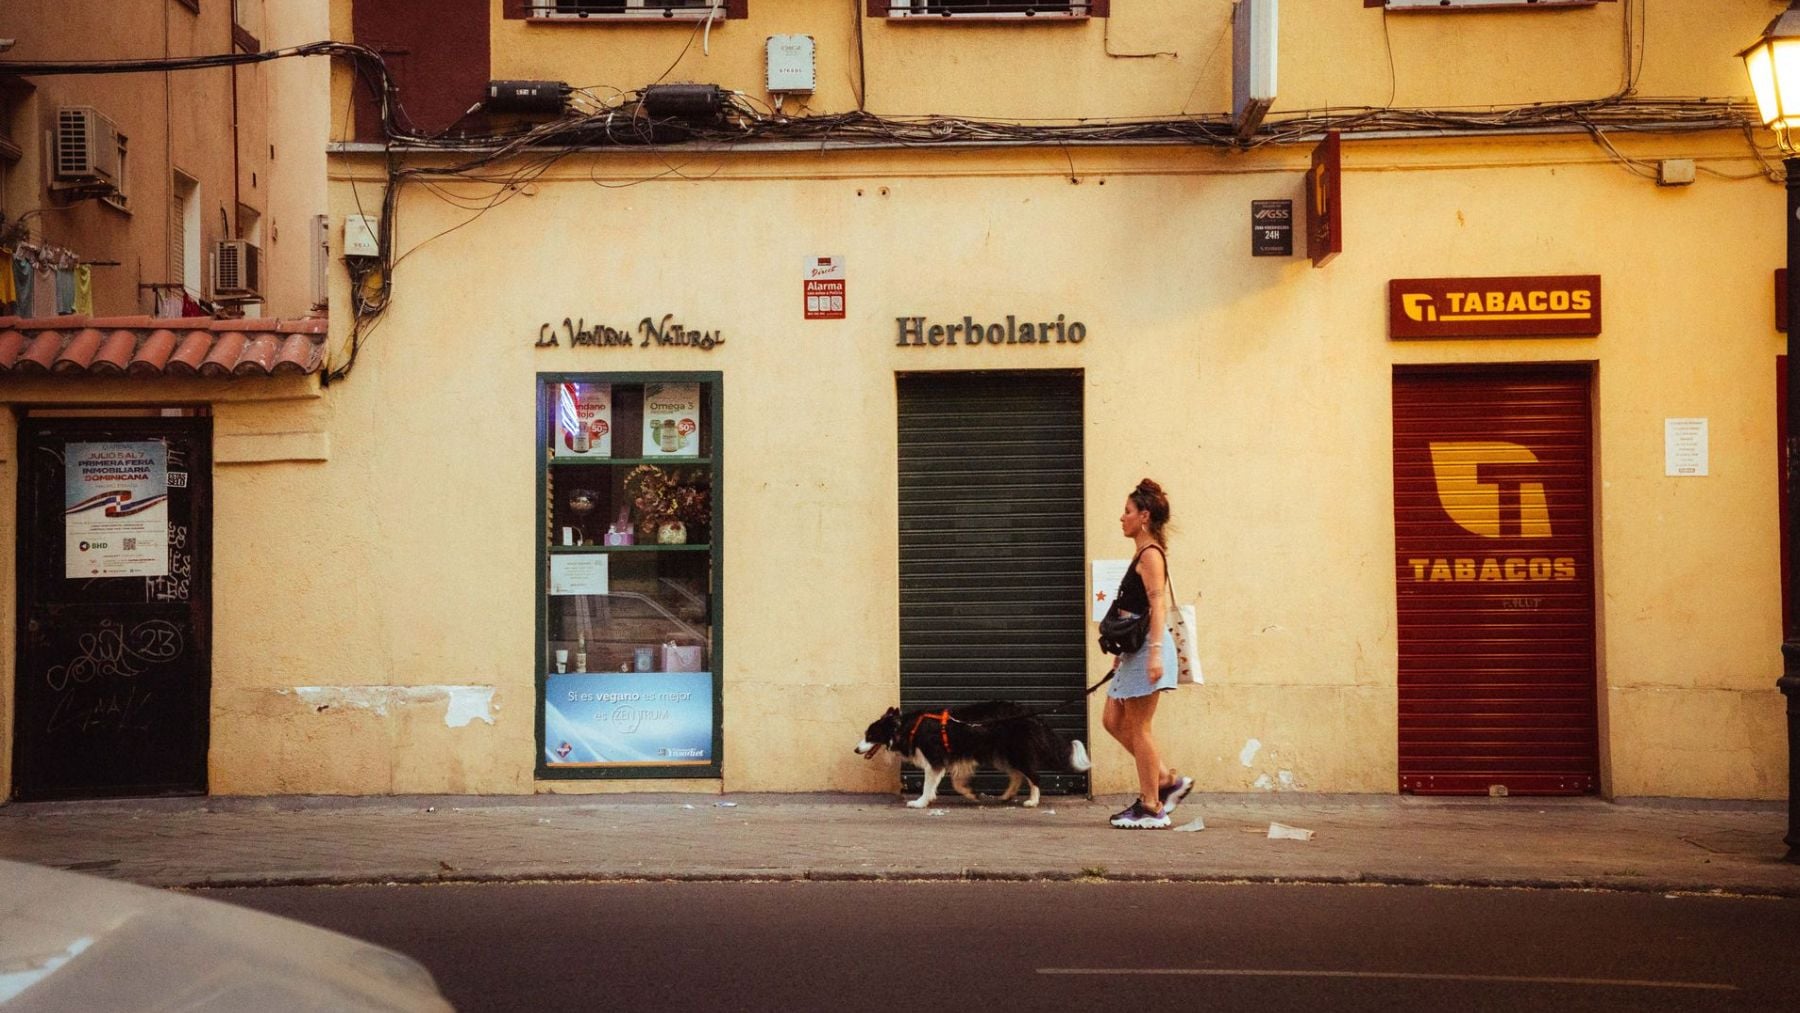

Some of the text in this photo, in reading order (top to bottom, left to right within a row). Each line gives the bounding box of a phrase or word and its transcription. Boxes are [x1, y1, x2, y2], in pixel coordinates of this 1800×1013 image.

[1264, 230, 1280, 240] 24H
[808, 281, 843, 291] Alarma
[1446, 289, 1592, 313] TABACOS
[535, 322, 560, 348] LA
[638, 313, 726, 351] NATURAL
[896, 313, 1087, 347] Herbolario
[650, 401, 695, 413] Omega 3
[88, 452, 116, 460] JULIO
[82, 466, 151, 474] INMOBILIARIA
[84, 473, 149, 482] DOMINICANA
[1408, 557, 1576, 582] TABACOS
[139, 628, 177, 657] 23
[568, 690, 579, 701] Si
[580, 693, 593, 701] es
[596, 692, 641, 704] vegano
